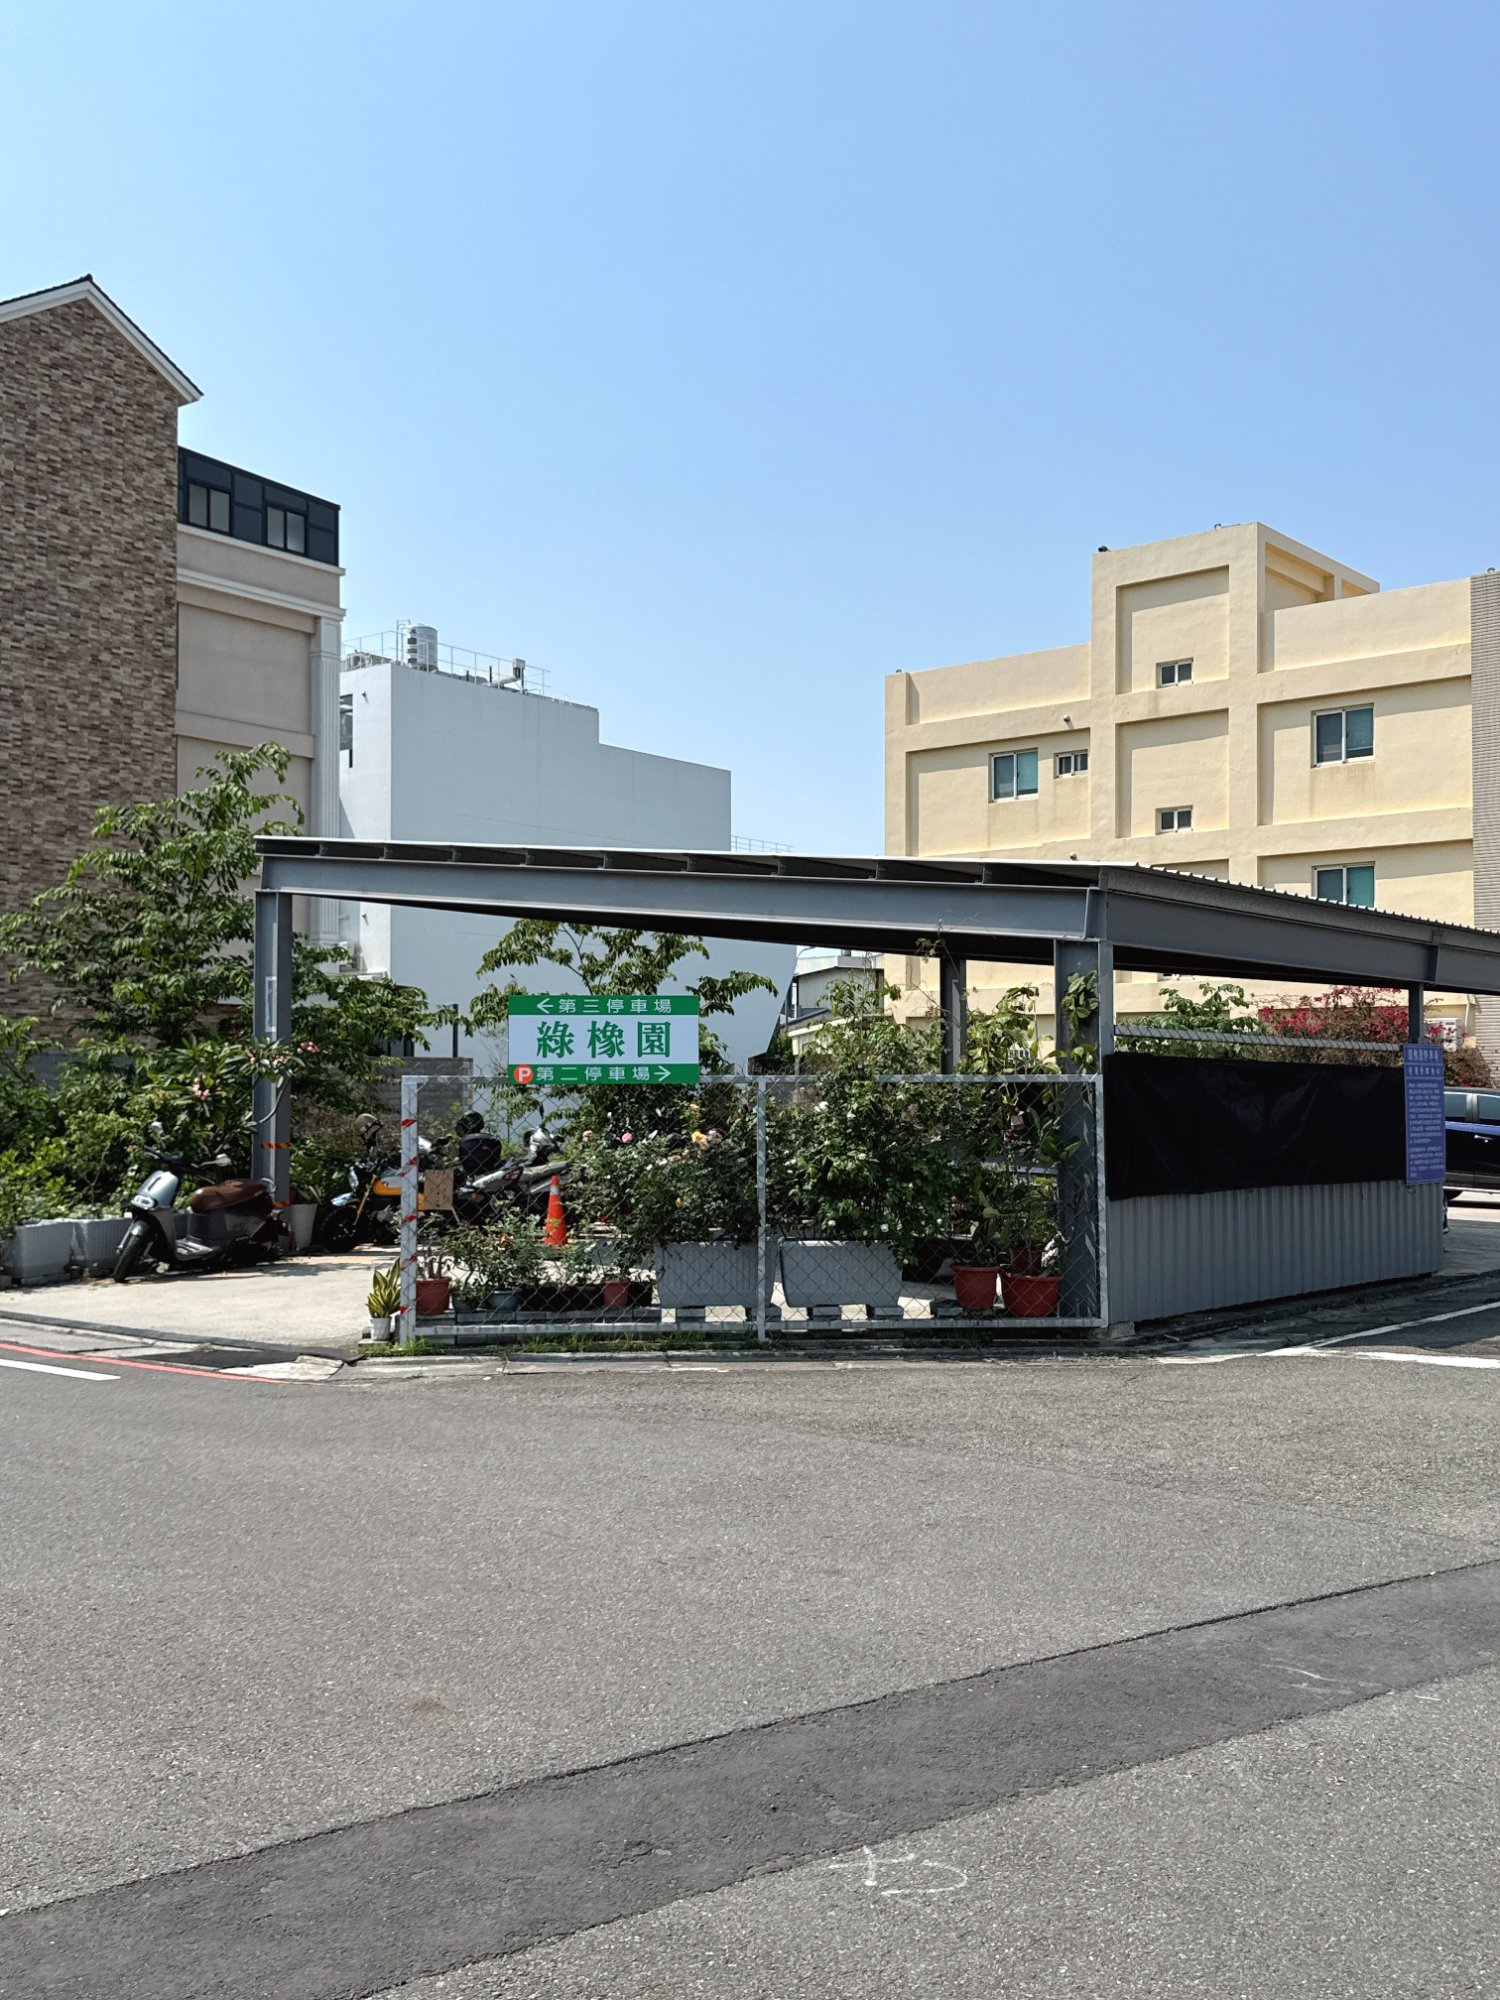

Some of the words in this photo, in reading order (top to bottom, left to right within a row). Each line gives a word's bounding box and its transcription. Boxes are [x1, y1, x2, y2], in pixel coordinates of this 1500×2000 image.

[559, 998, 671, 1014] 第三停車場
[536, 1020, 671, 1059] 綠橡園
[518, 1067, 532, 1083] P
[536, 1066, 650, 1081] 第二停車場
